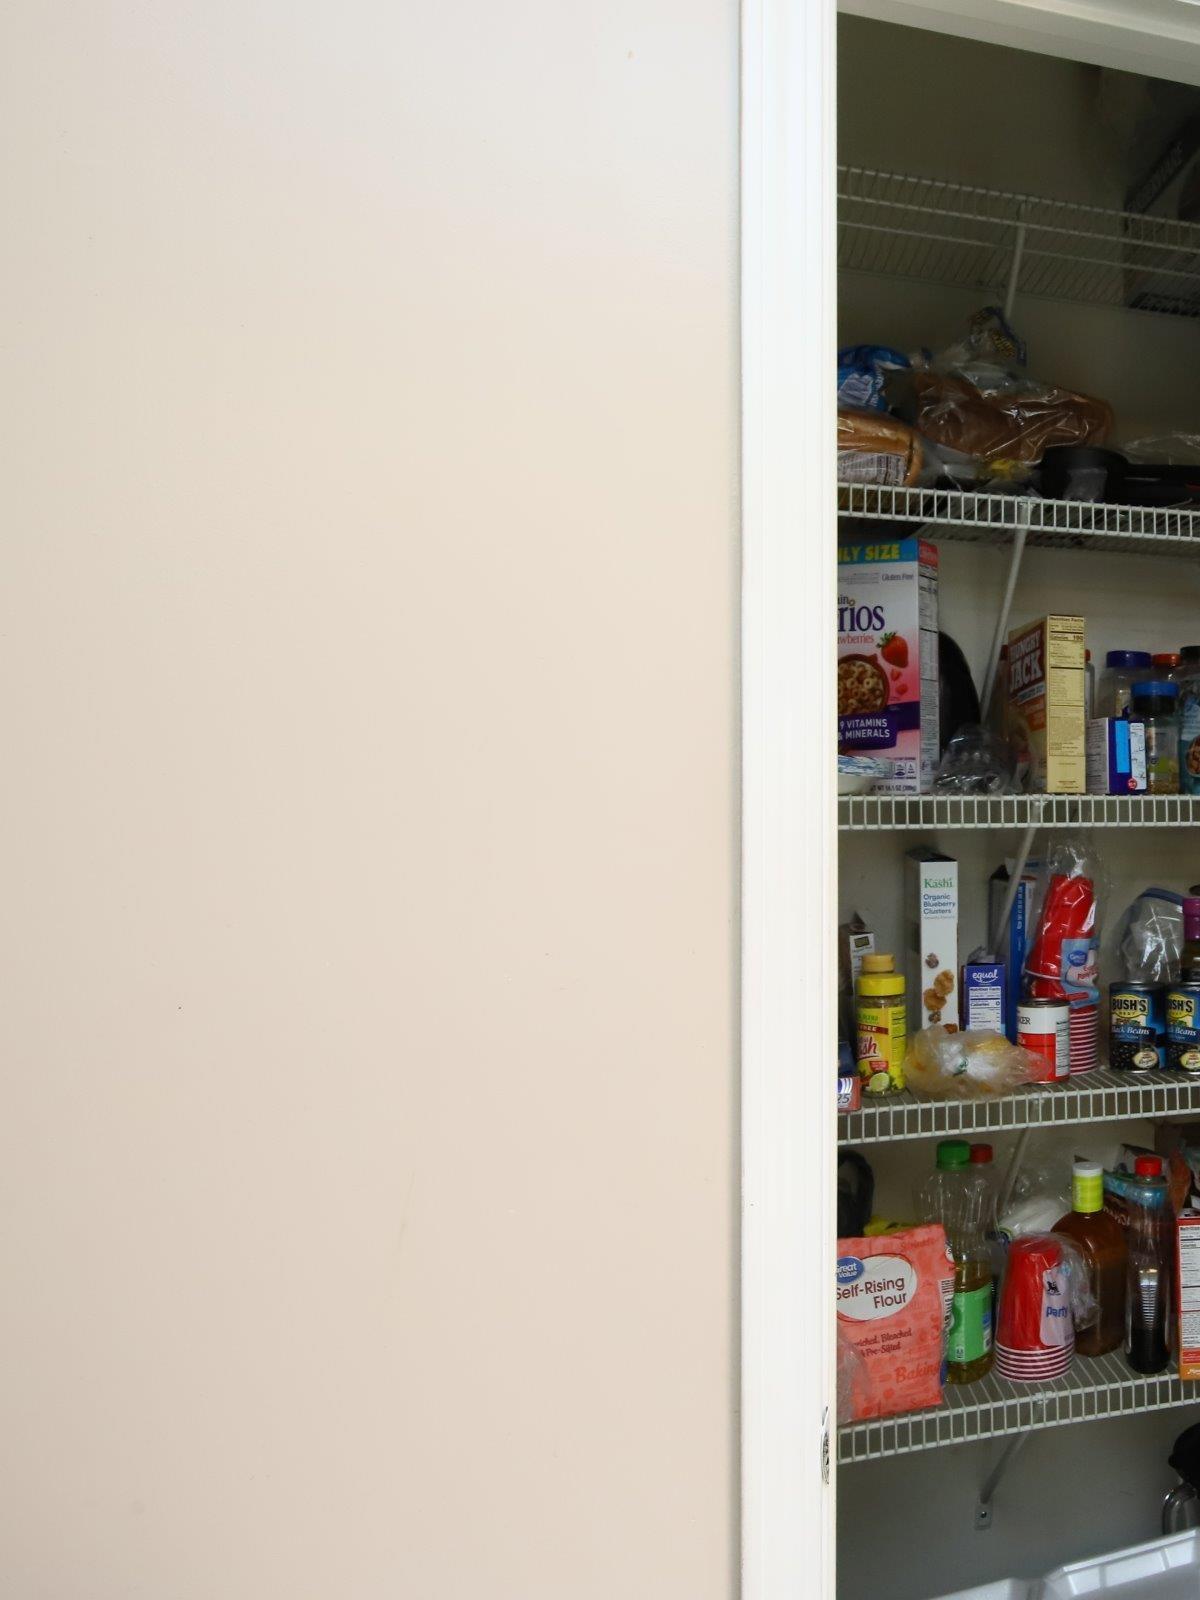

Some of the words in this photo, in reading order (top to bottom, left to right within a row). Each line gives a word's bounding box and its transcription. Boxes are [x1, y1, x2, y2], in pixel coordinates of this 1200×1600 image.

[865, 543, 900, 561] SIZE
[1009, 649, 1043, 693] JACK
[846, 718, 888, 730] VITAMINS
[845, 729, 891, 740] MINERALS
[924, 877, 953, 888] Kashi
[923, 893, 951, 901] Organic
[972, 969, 999, 983] equal
[1127, 1026, 1150, 1035] Beans
[1175, 1026, 1197, 1036] Beans
[837, 1277, 905, 1299] Self-Rising
[874, 1293, 907, 1309] Flour
[881, 1328, 912, 1343] Bleached
